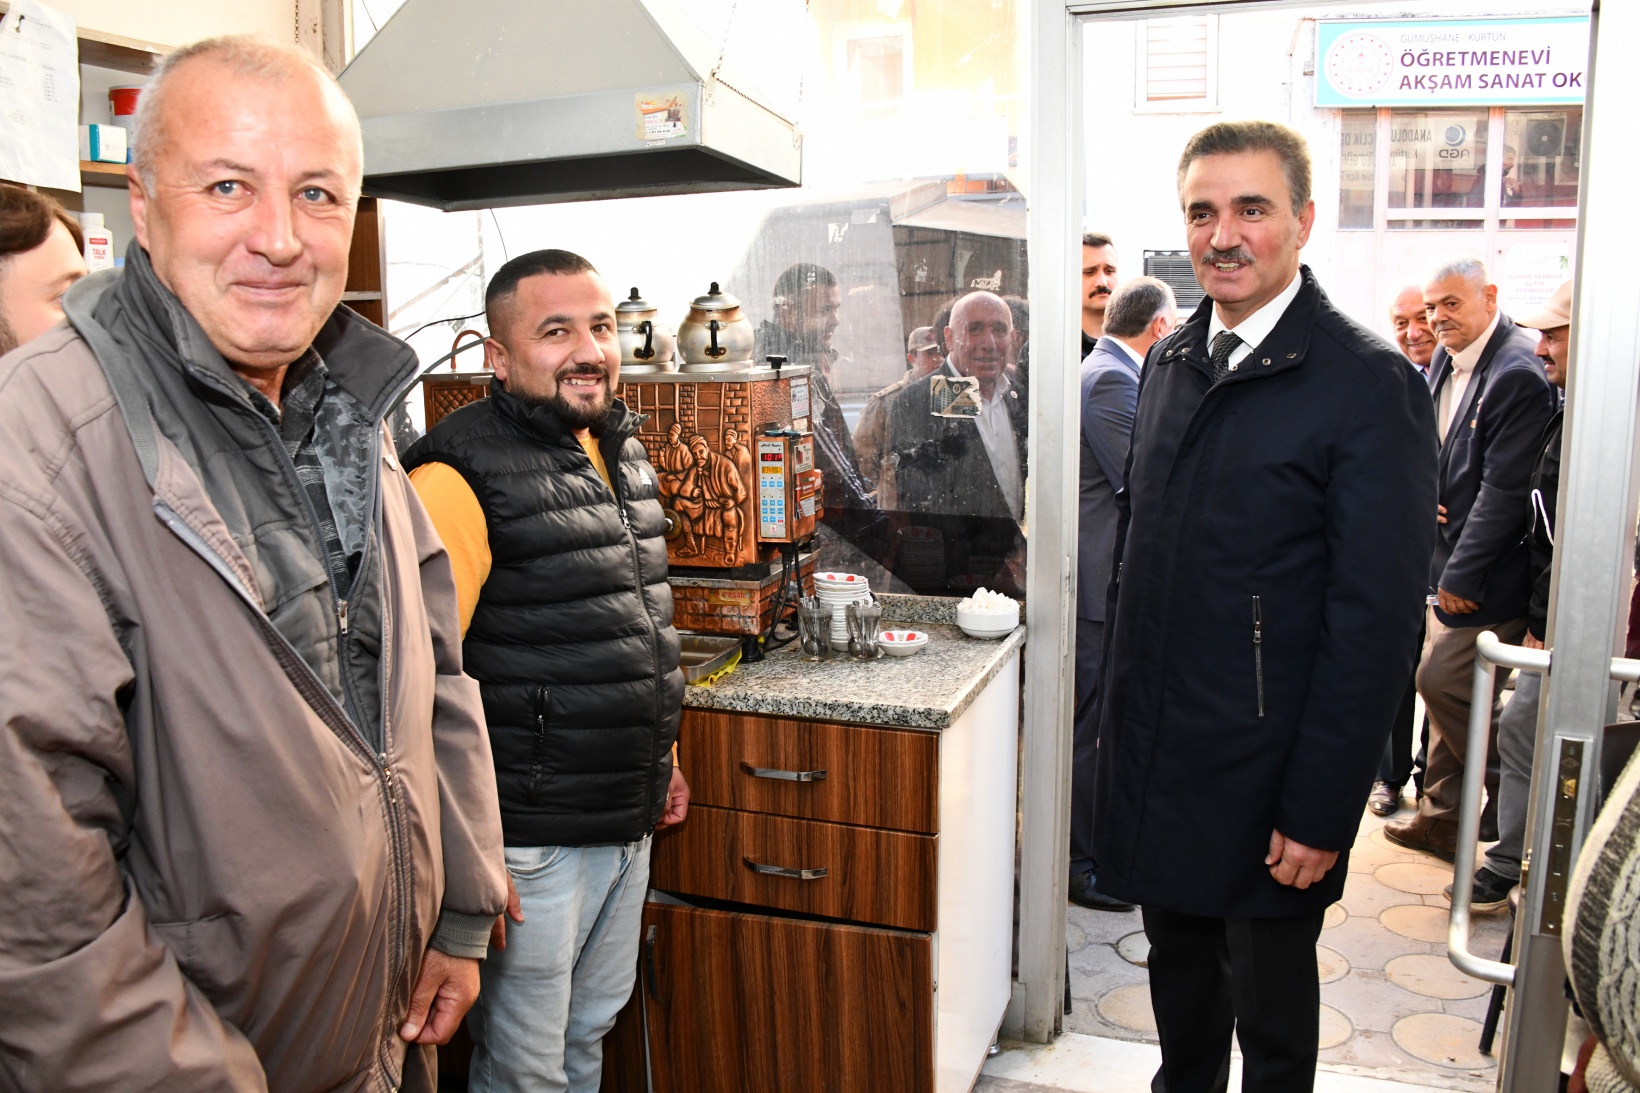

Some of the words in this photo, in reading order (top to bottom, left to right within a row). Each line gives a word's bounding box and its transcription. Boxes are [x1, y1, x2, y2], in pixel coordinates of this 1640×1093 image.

[1400, 33, 1460, 44] GÜMÜŞHANE
[1468, 32, 1507, 42] KÜRTÜN
[1400, 46, 1551, 67] ÖĞRETMENEVİ
[1399, 74, 1472, 93] AKŞAM
[1478, 73, 1547, 89] SANAT
[1552, 72, 1583, 88] OK
[92, 248, 106, 256] TALK
